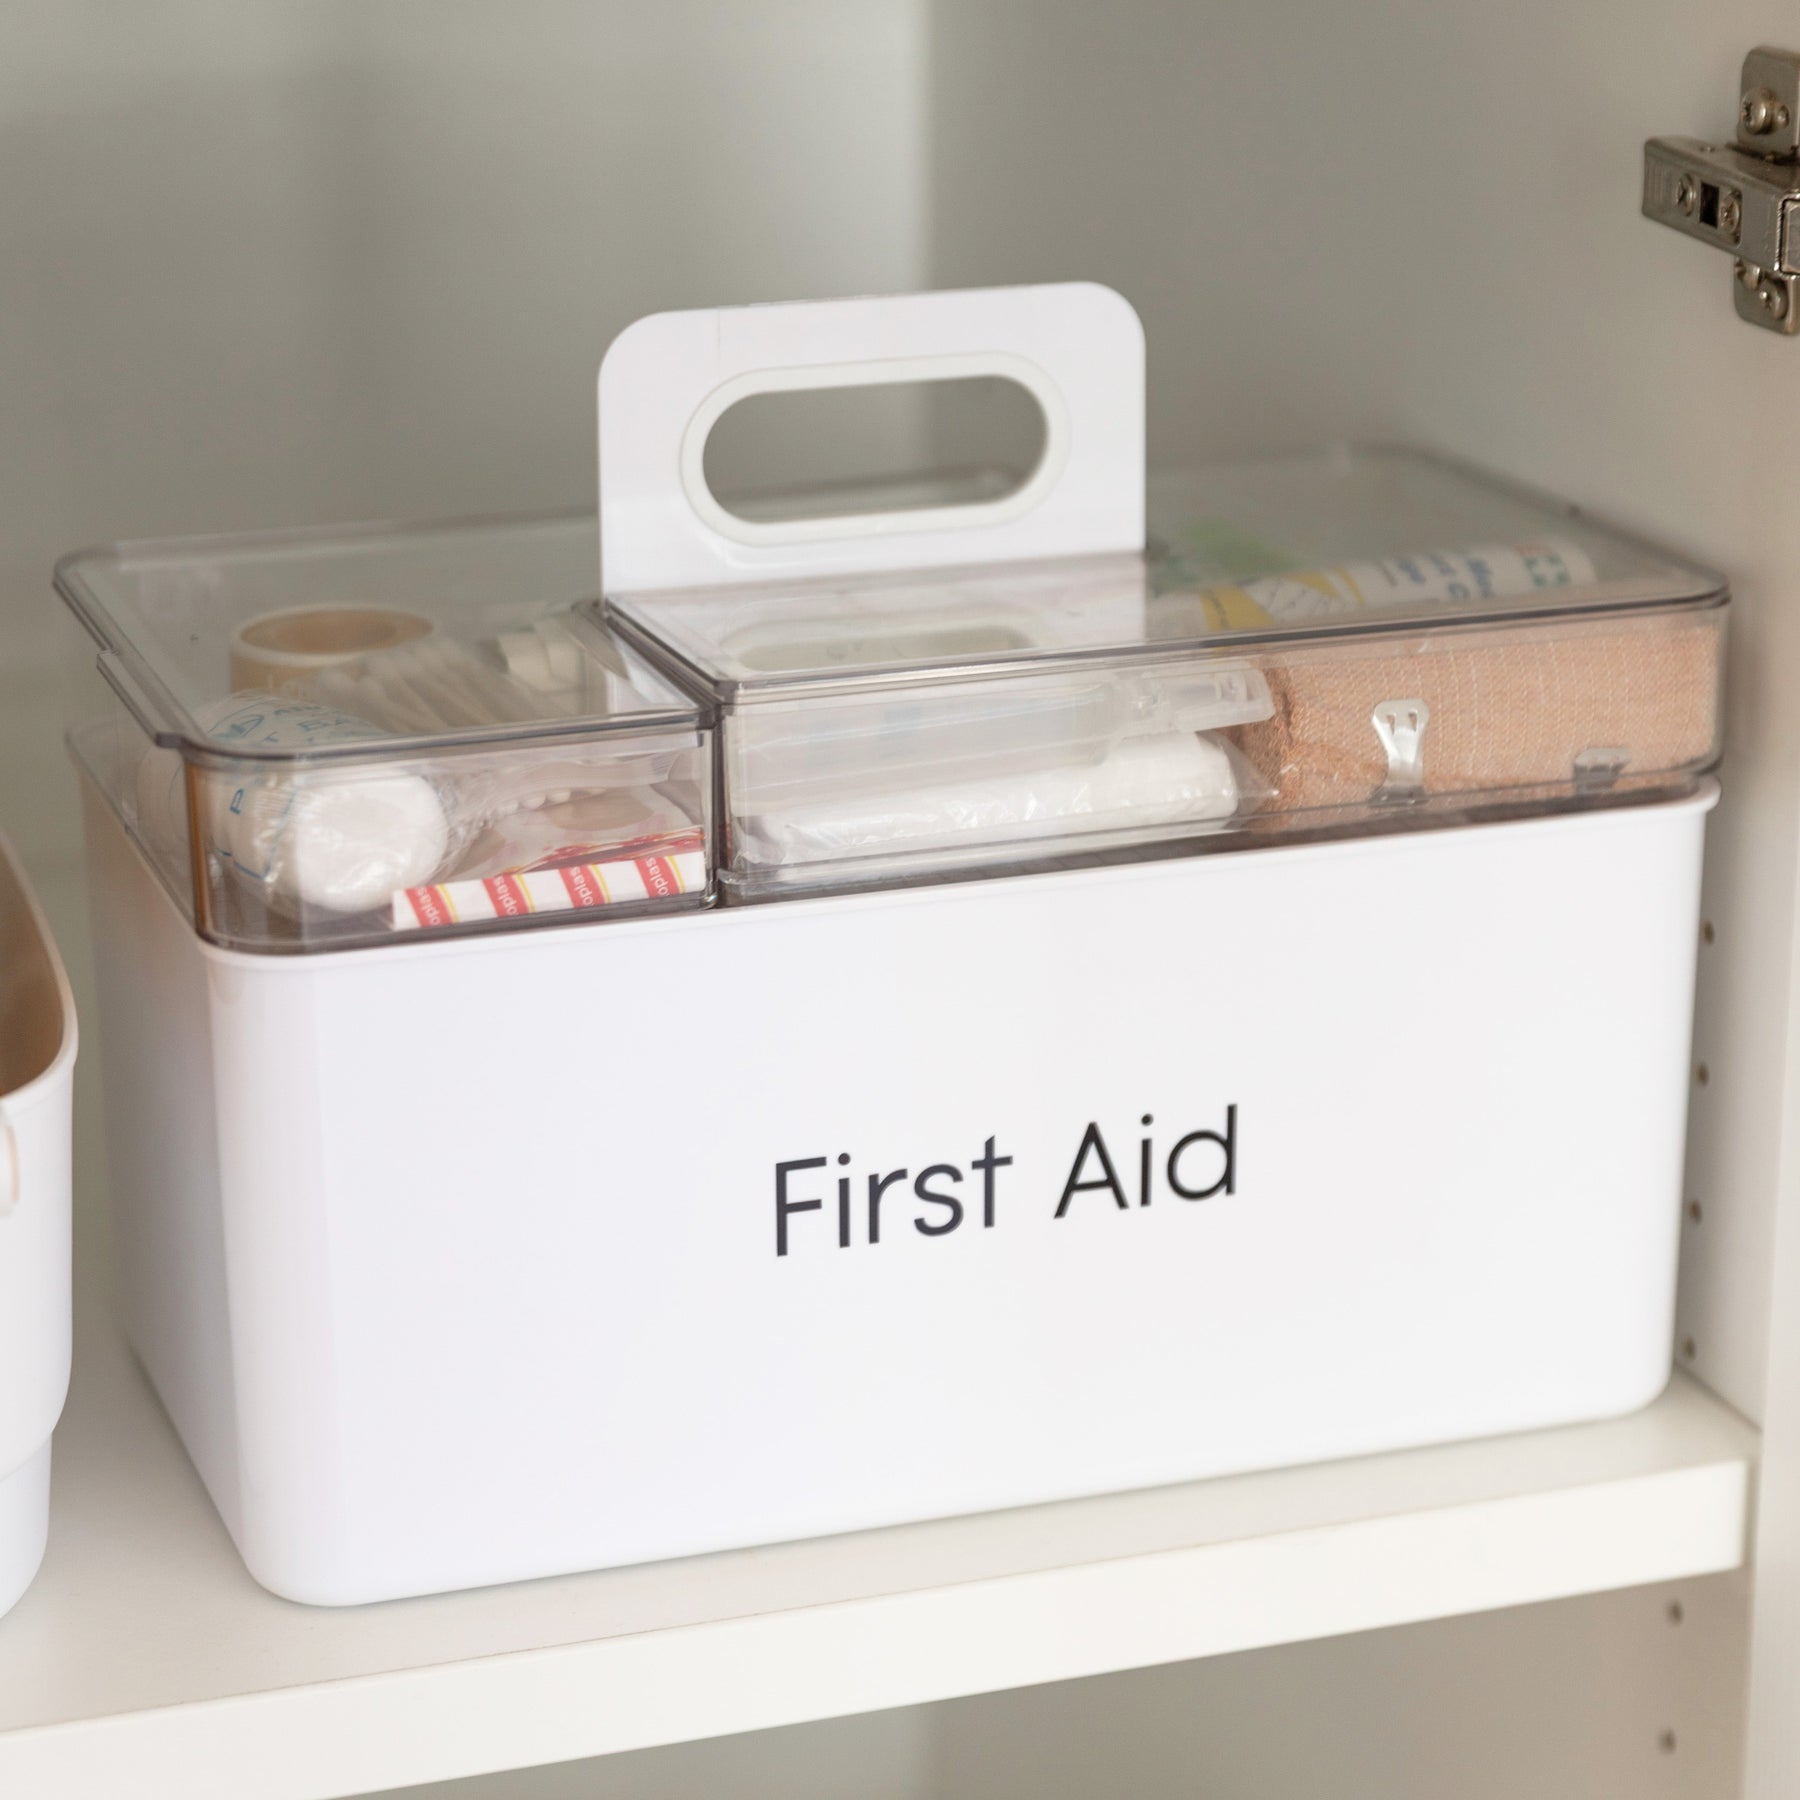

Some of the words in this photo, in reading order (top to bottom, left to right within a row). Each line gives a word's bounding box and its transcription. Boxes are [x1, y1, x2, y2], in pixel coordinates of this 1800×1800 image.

[492, 875, 519, 917] oplas
[568, 866, 595, 907] oplas
[645, 856, 670, 897] oplas
[774, 1134, 1014, 1257] First
[1053, 1103, 1238, 1220] Aid
